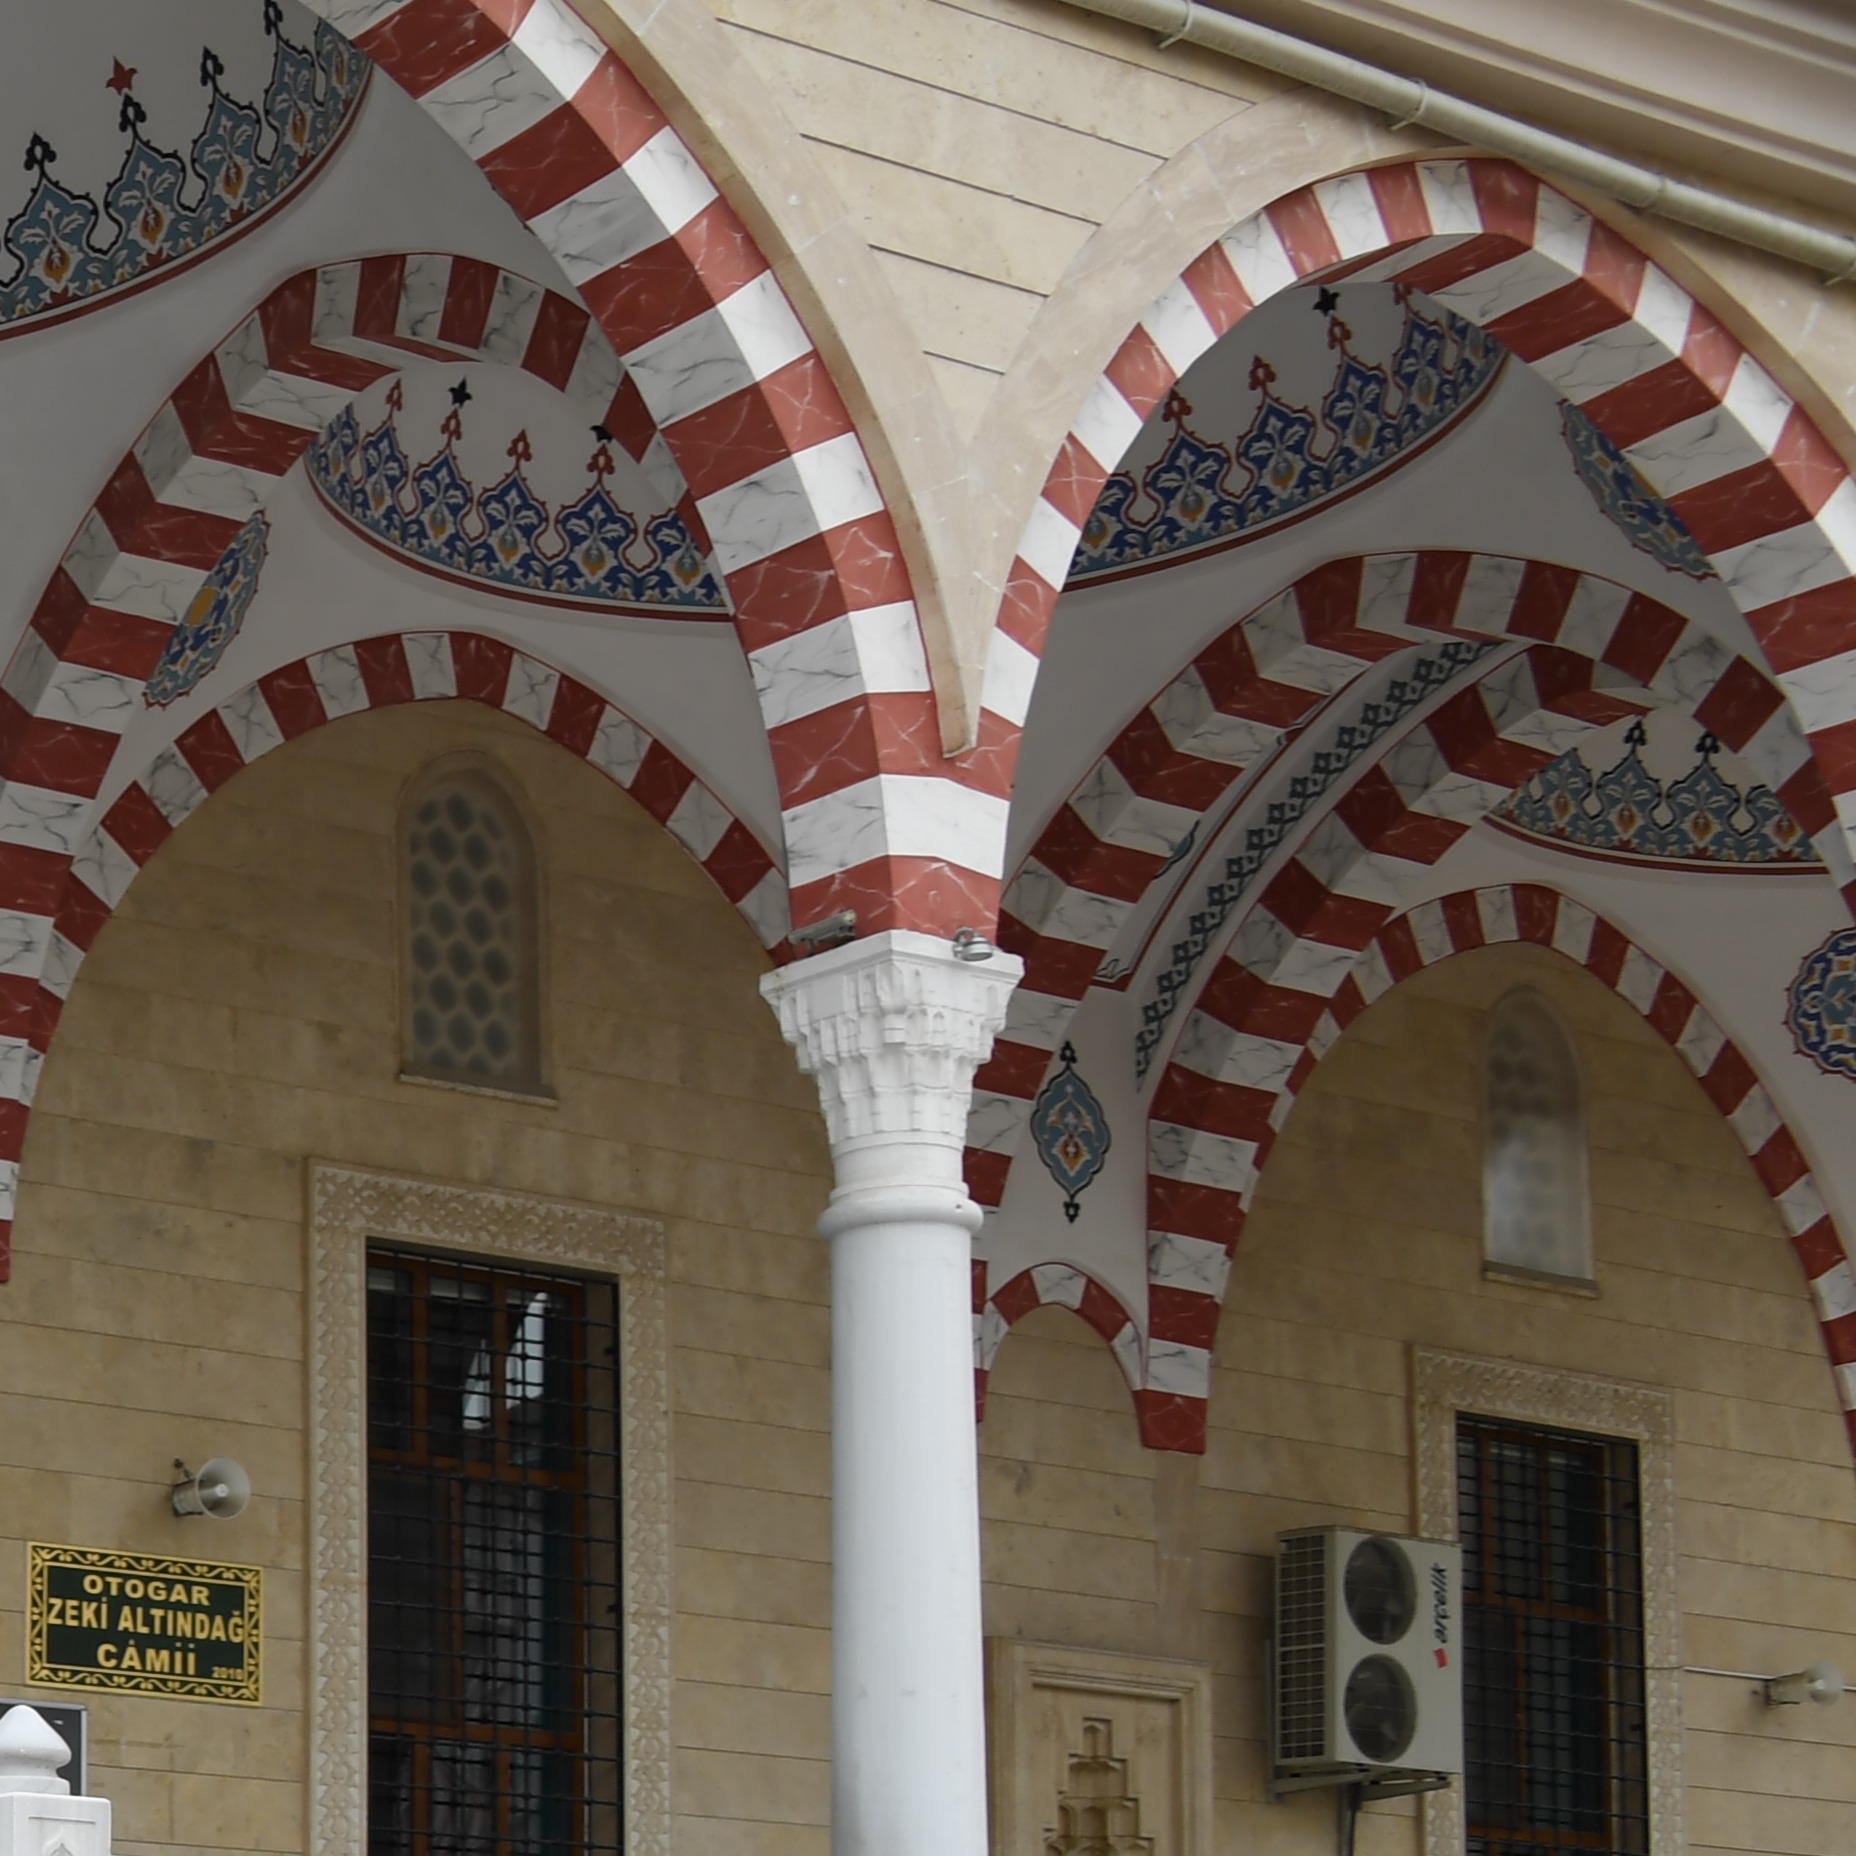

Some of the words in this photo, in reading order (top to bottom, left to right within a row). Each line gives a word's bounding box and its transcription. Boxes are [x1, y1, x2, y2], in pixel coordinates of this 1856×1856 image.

[83, 1574, 211, 1606] OTOGAR
[47, 1597, 108, 1630] ZEKİ
[117, 1605, 245, 1644] ALTINDAĞ
